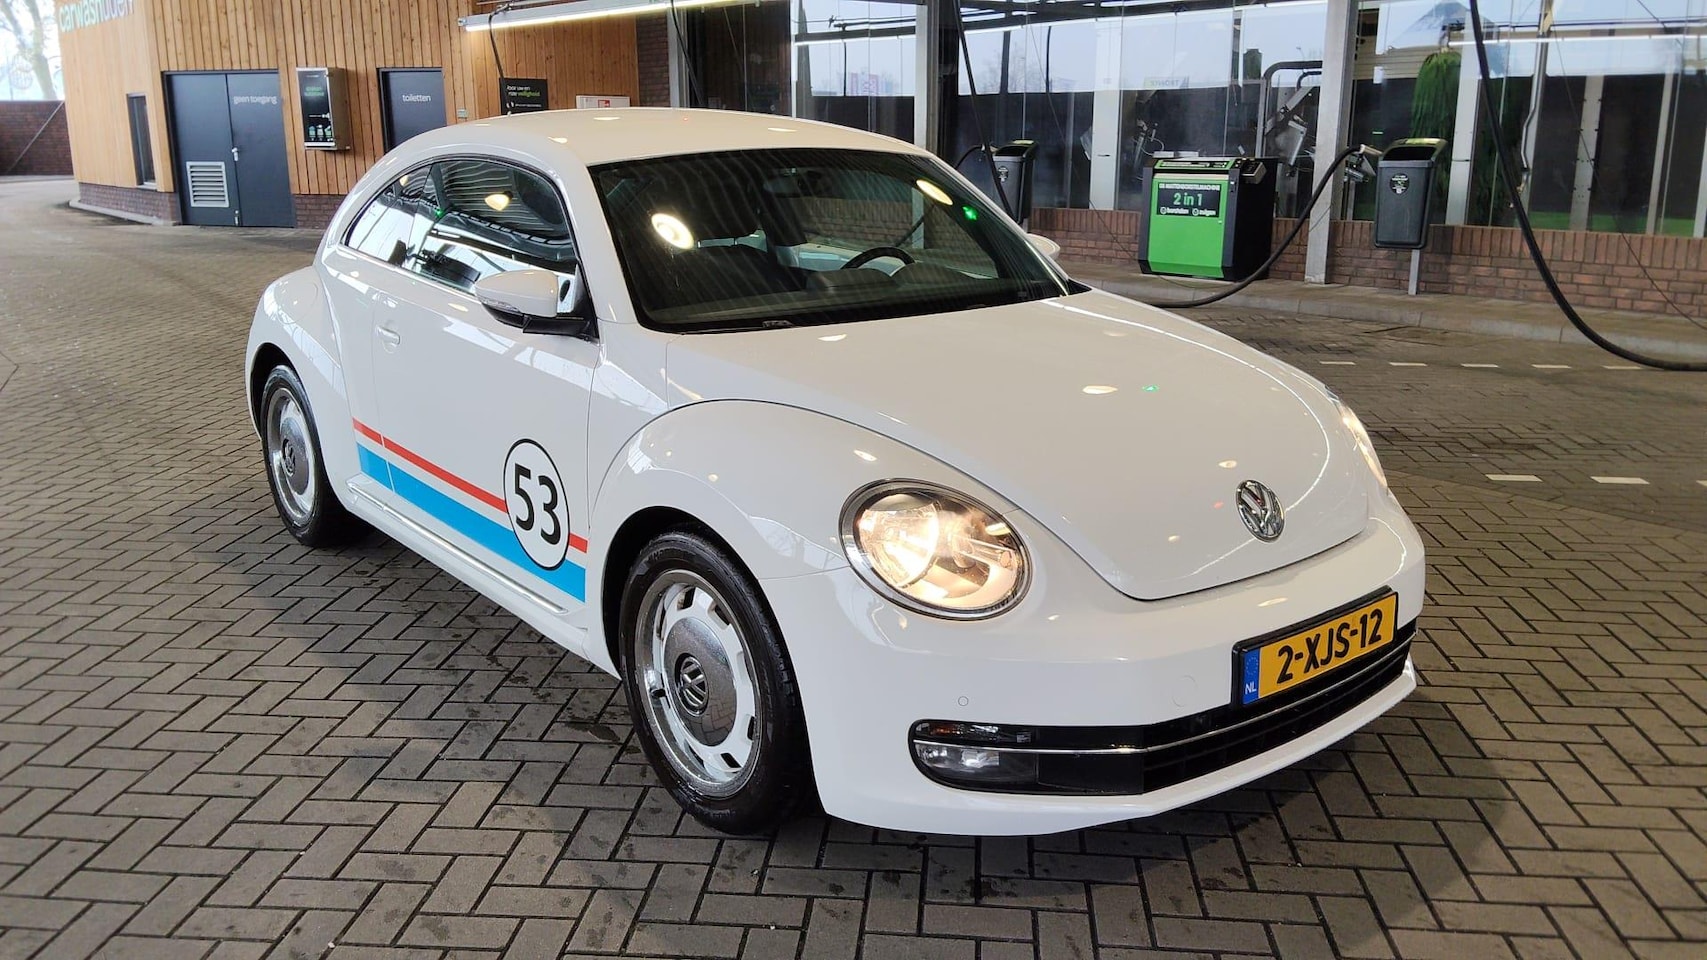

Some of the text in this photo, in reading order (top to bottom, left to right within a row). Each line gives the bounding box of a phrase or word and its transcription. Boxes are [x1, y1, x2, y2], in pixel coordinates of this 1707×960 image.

[233, 95, 278, 105] geen toegang
[402, 93, 432, 102] toiletten
[1173, 192, 1203, 206] 2 in 1
[515, 462, 562, 546] 53
[1276, 608, 1384, 684] 2-XJS-12
[1244, 681, 1258, 695] NL
